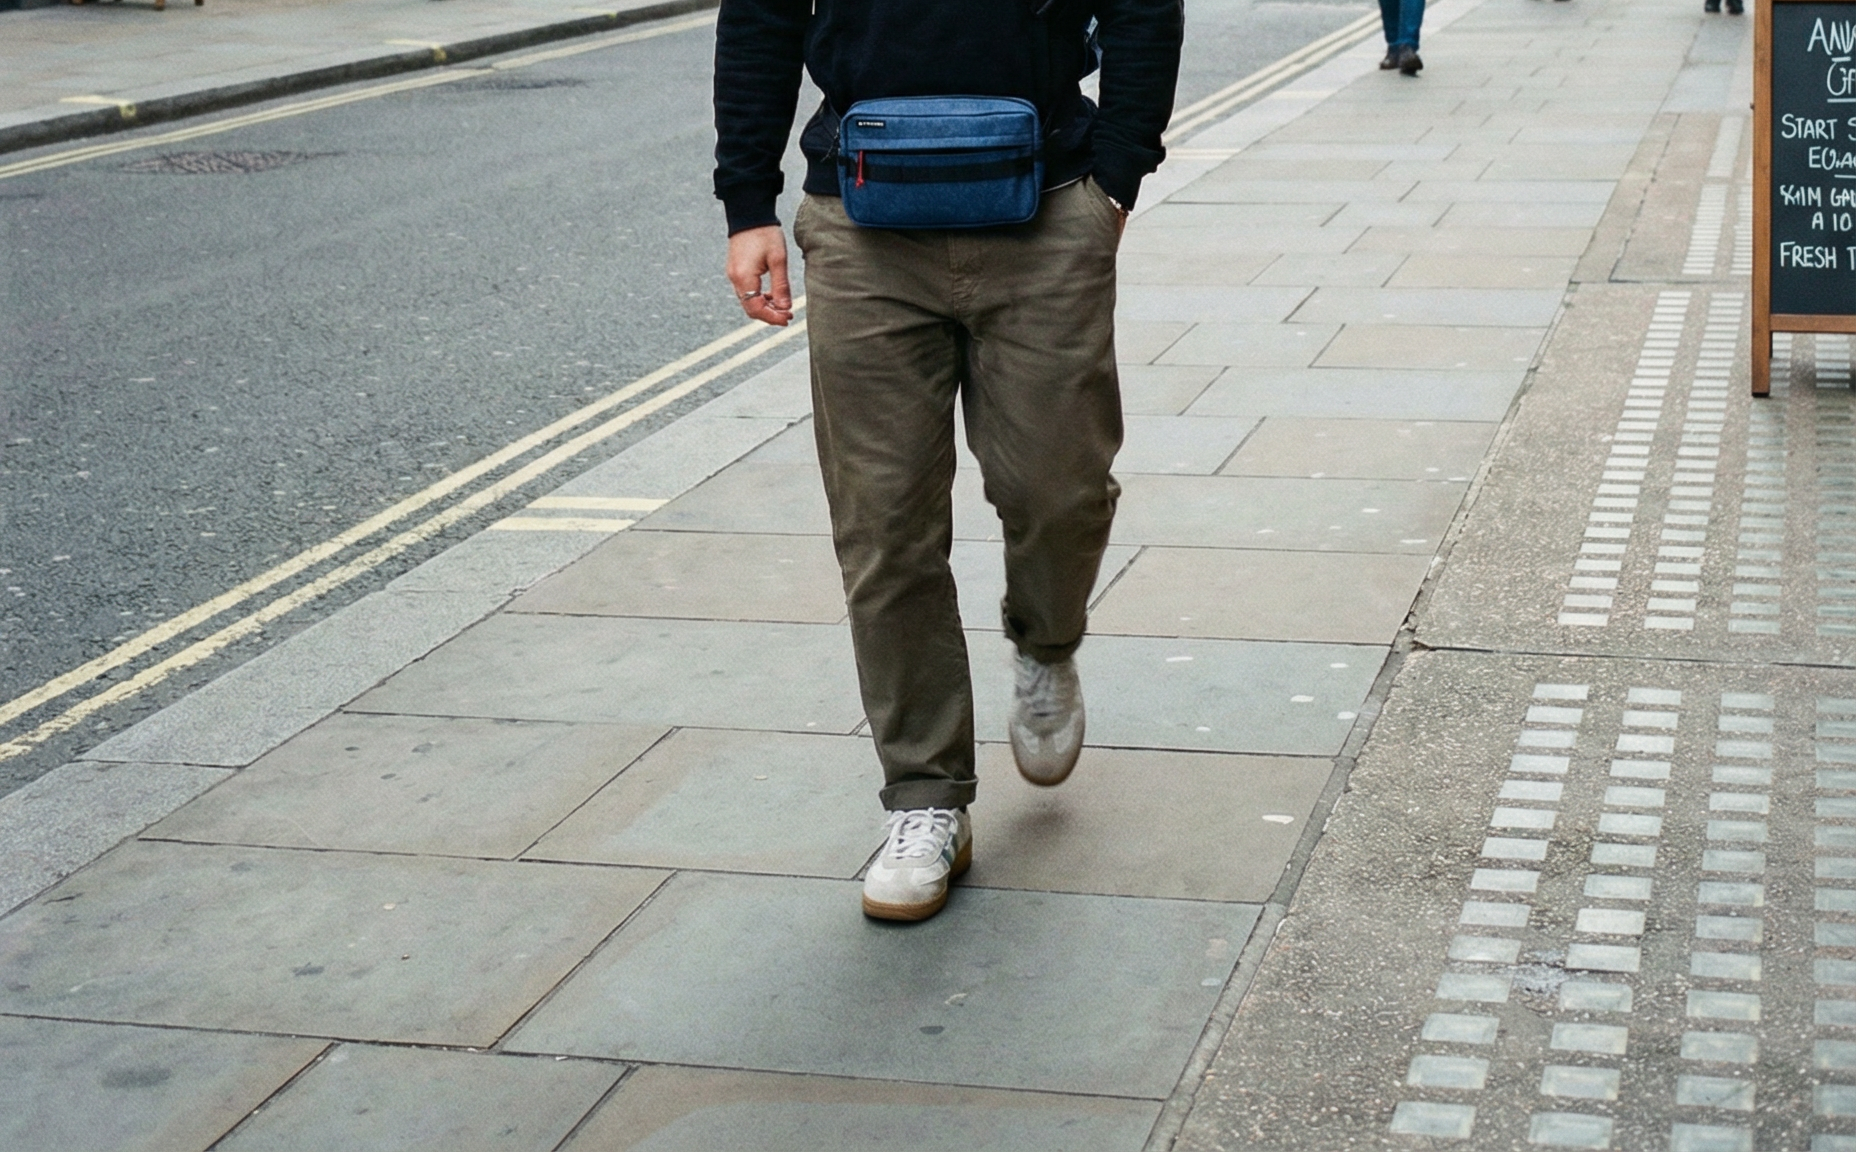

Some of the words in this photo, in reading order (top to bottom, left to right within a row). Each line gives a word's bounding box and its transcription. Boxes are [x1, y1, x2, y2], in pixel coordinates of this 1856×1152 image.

[1781, 113, 1838, 140] START
[1811, 211, 1824, 230] A
[1780, 241, 1837, 269] FRESH
